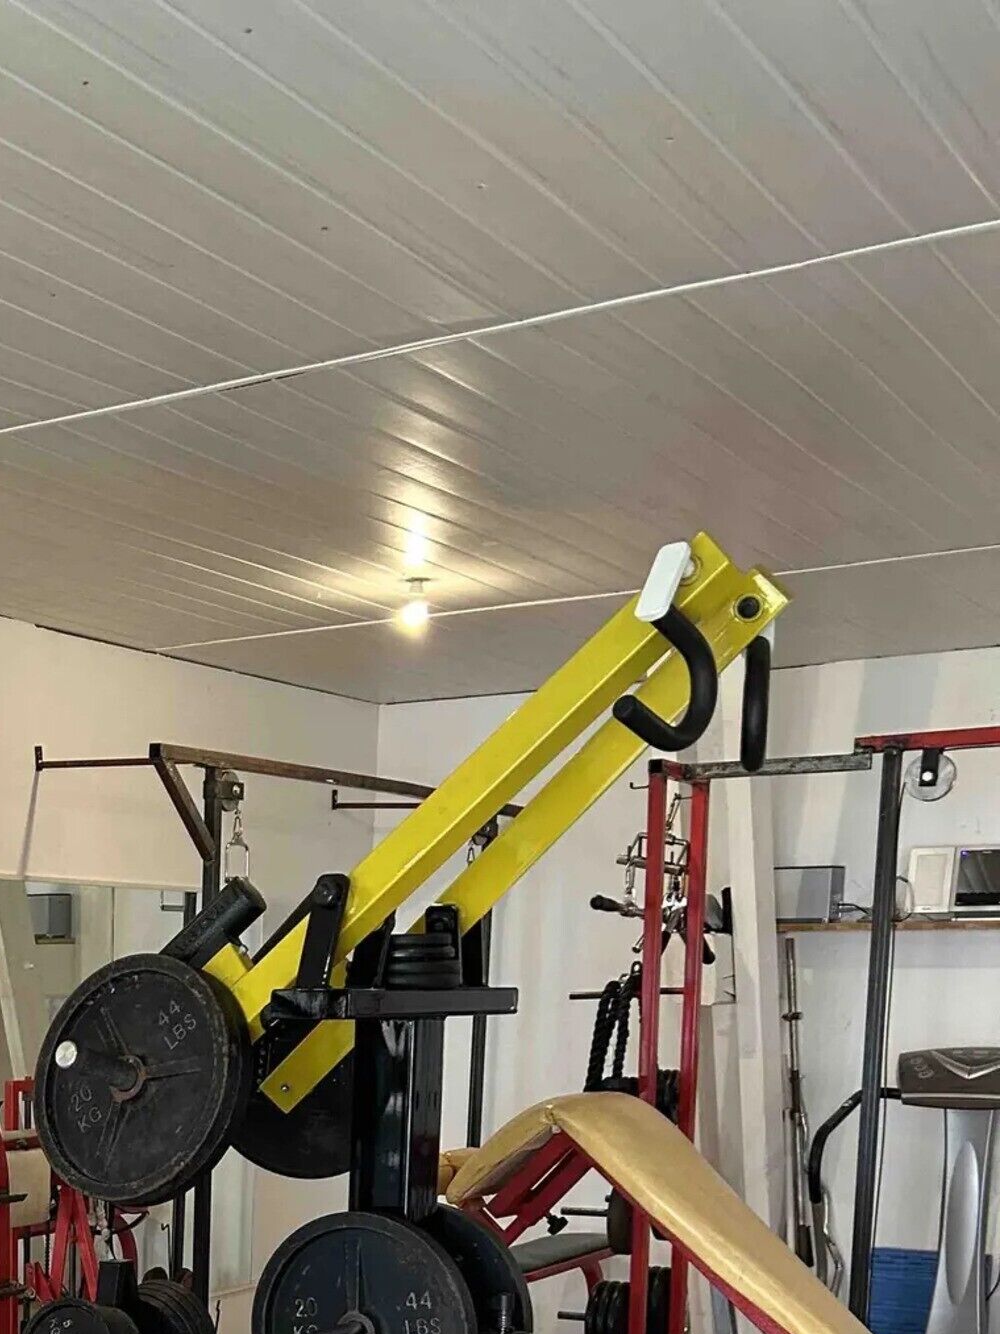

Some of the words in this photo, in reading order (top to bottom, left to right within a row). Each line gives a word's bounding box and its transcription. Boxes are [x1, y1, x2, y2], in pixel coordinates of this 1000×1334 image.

[158, 999, 181, 1026] 44
[163, 1013, 197, 1050] LBS
[70, 1086, 92, 1112] 20
[77, 1106, 102, 1133] KG
[405, 1290, 432, 1310] 44
